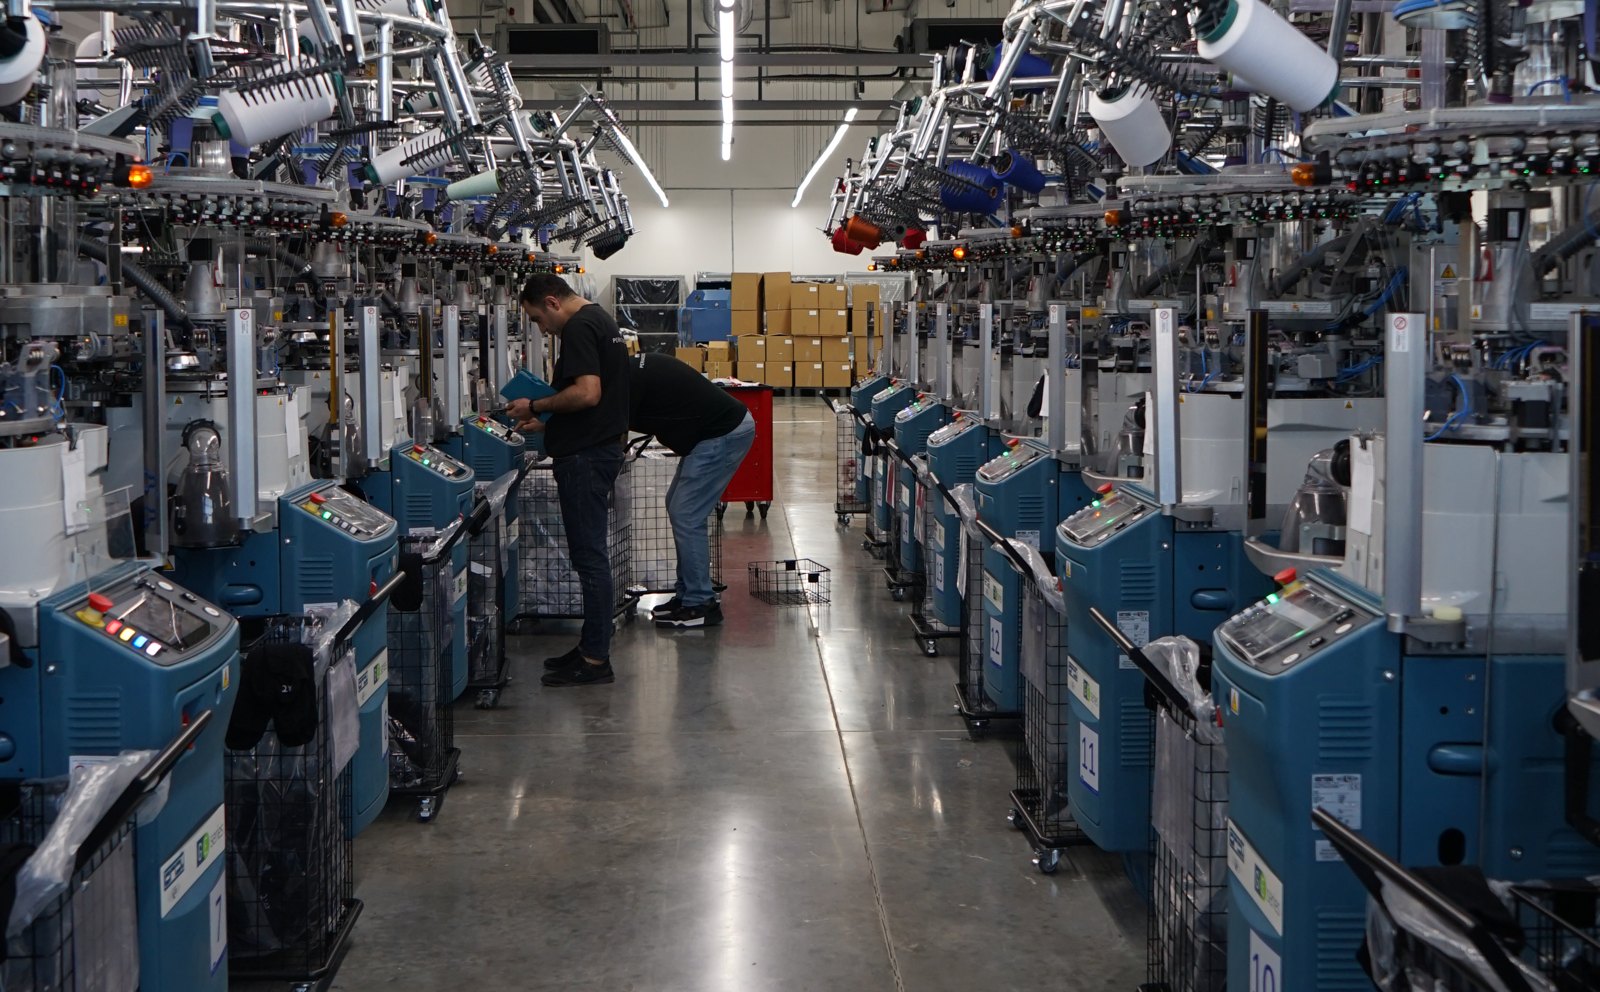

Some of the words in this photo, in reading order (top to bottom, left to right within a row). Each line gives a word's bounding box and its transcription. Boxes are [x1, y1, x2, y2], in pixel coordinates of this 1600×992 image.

[991, 627, 1000, 655] 12
[1082, 737, 1096, 776] 11
[215, 895, 222, 943] 7
[1252, 953, 1275, 992] 10
